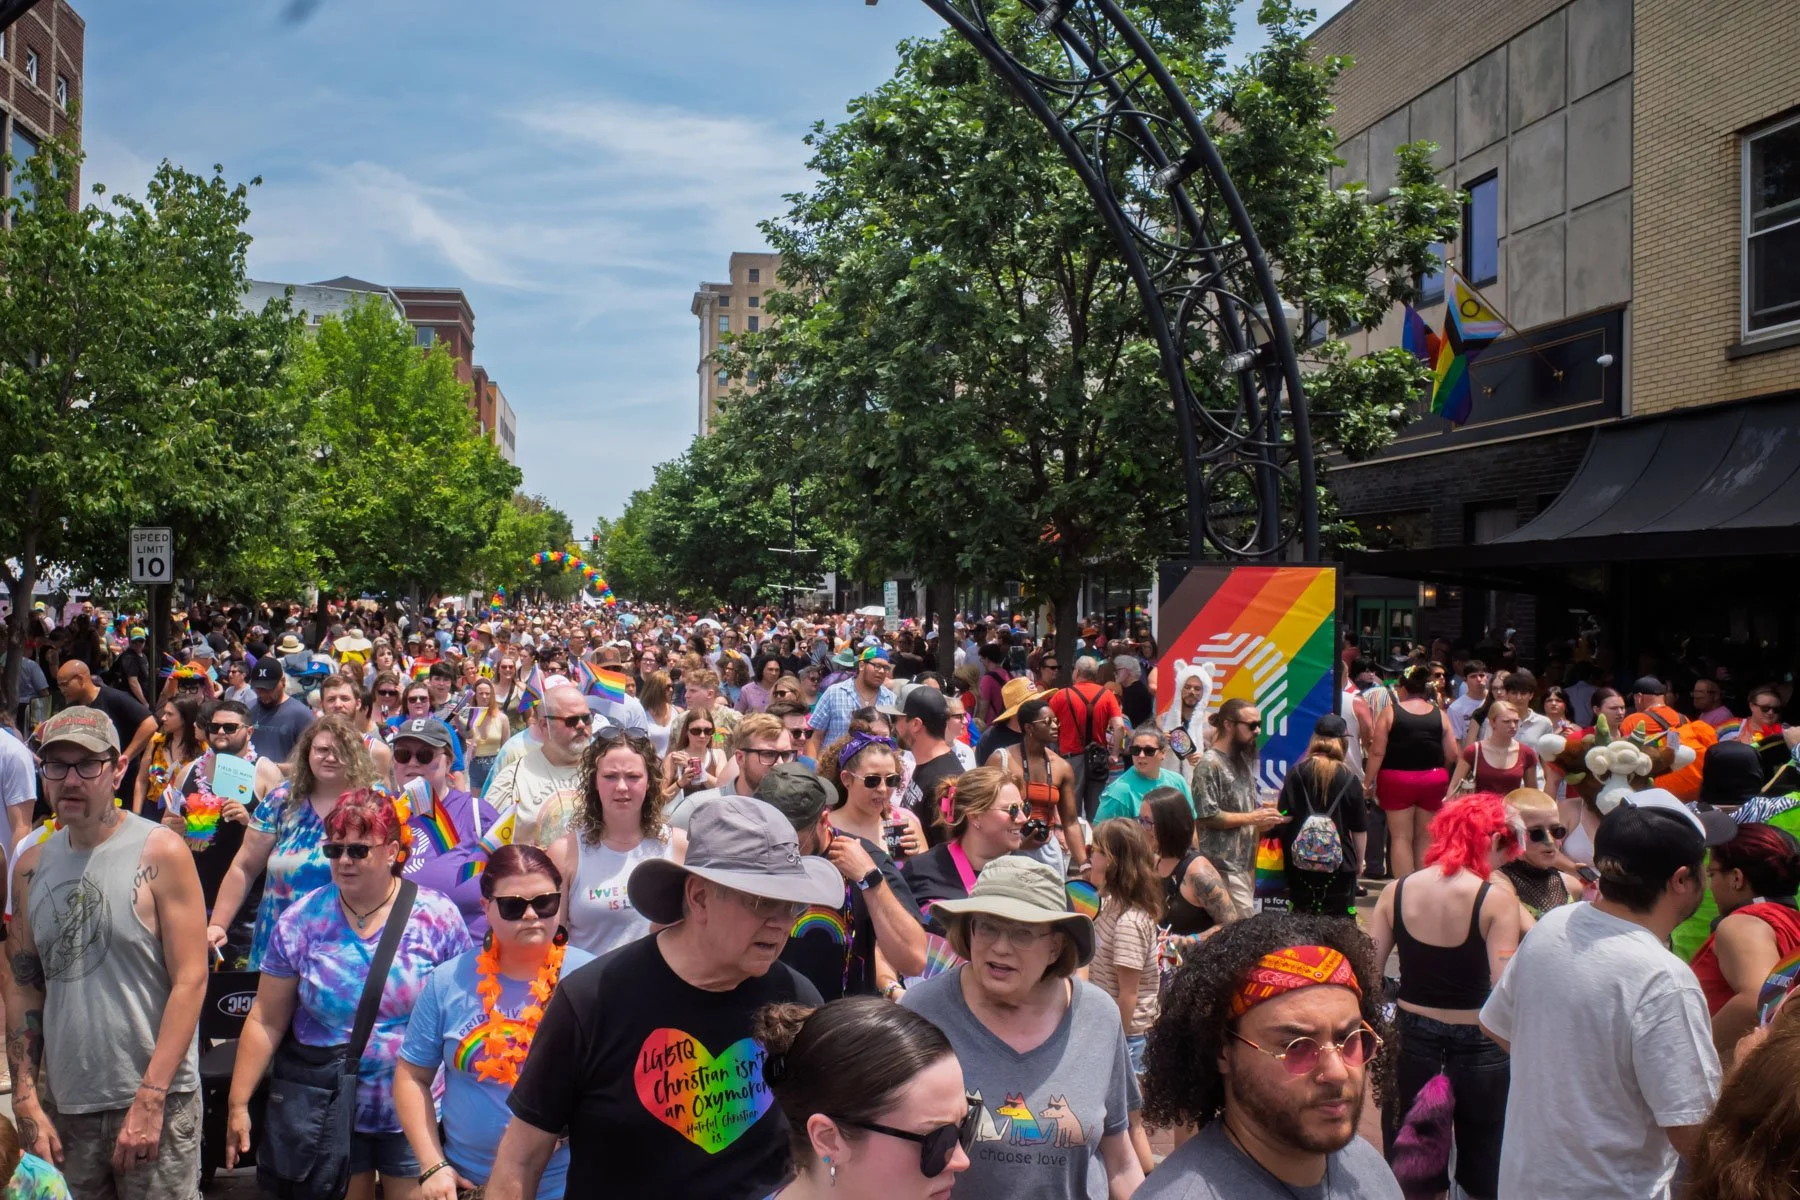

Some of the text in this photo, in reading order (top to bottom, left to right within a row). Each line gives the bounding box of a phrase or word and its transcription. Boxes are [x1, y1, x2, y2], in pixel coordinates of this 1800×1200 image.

[133, 533, 169, 542] SPEED
[136, 545, 165, 554] LIMIT
[137, 556, 165, 577] 10
[1272, 896, 1284, 905] for
[458, 1012, 491, 1037] PRID
[643, 1038, 697, 1074] LGBTQ
[665, 1103, 686, 1119] an
[721, 1108, 758, 1128] Christian
[980, 1147, 1067, 1166] choose love
